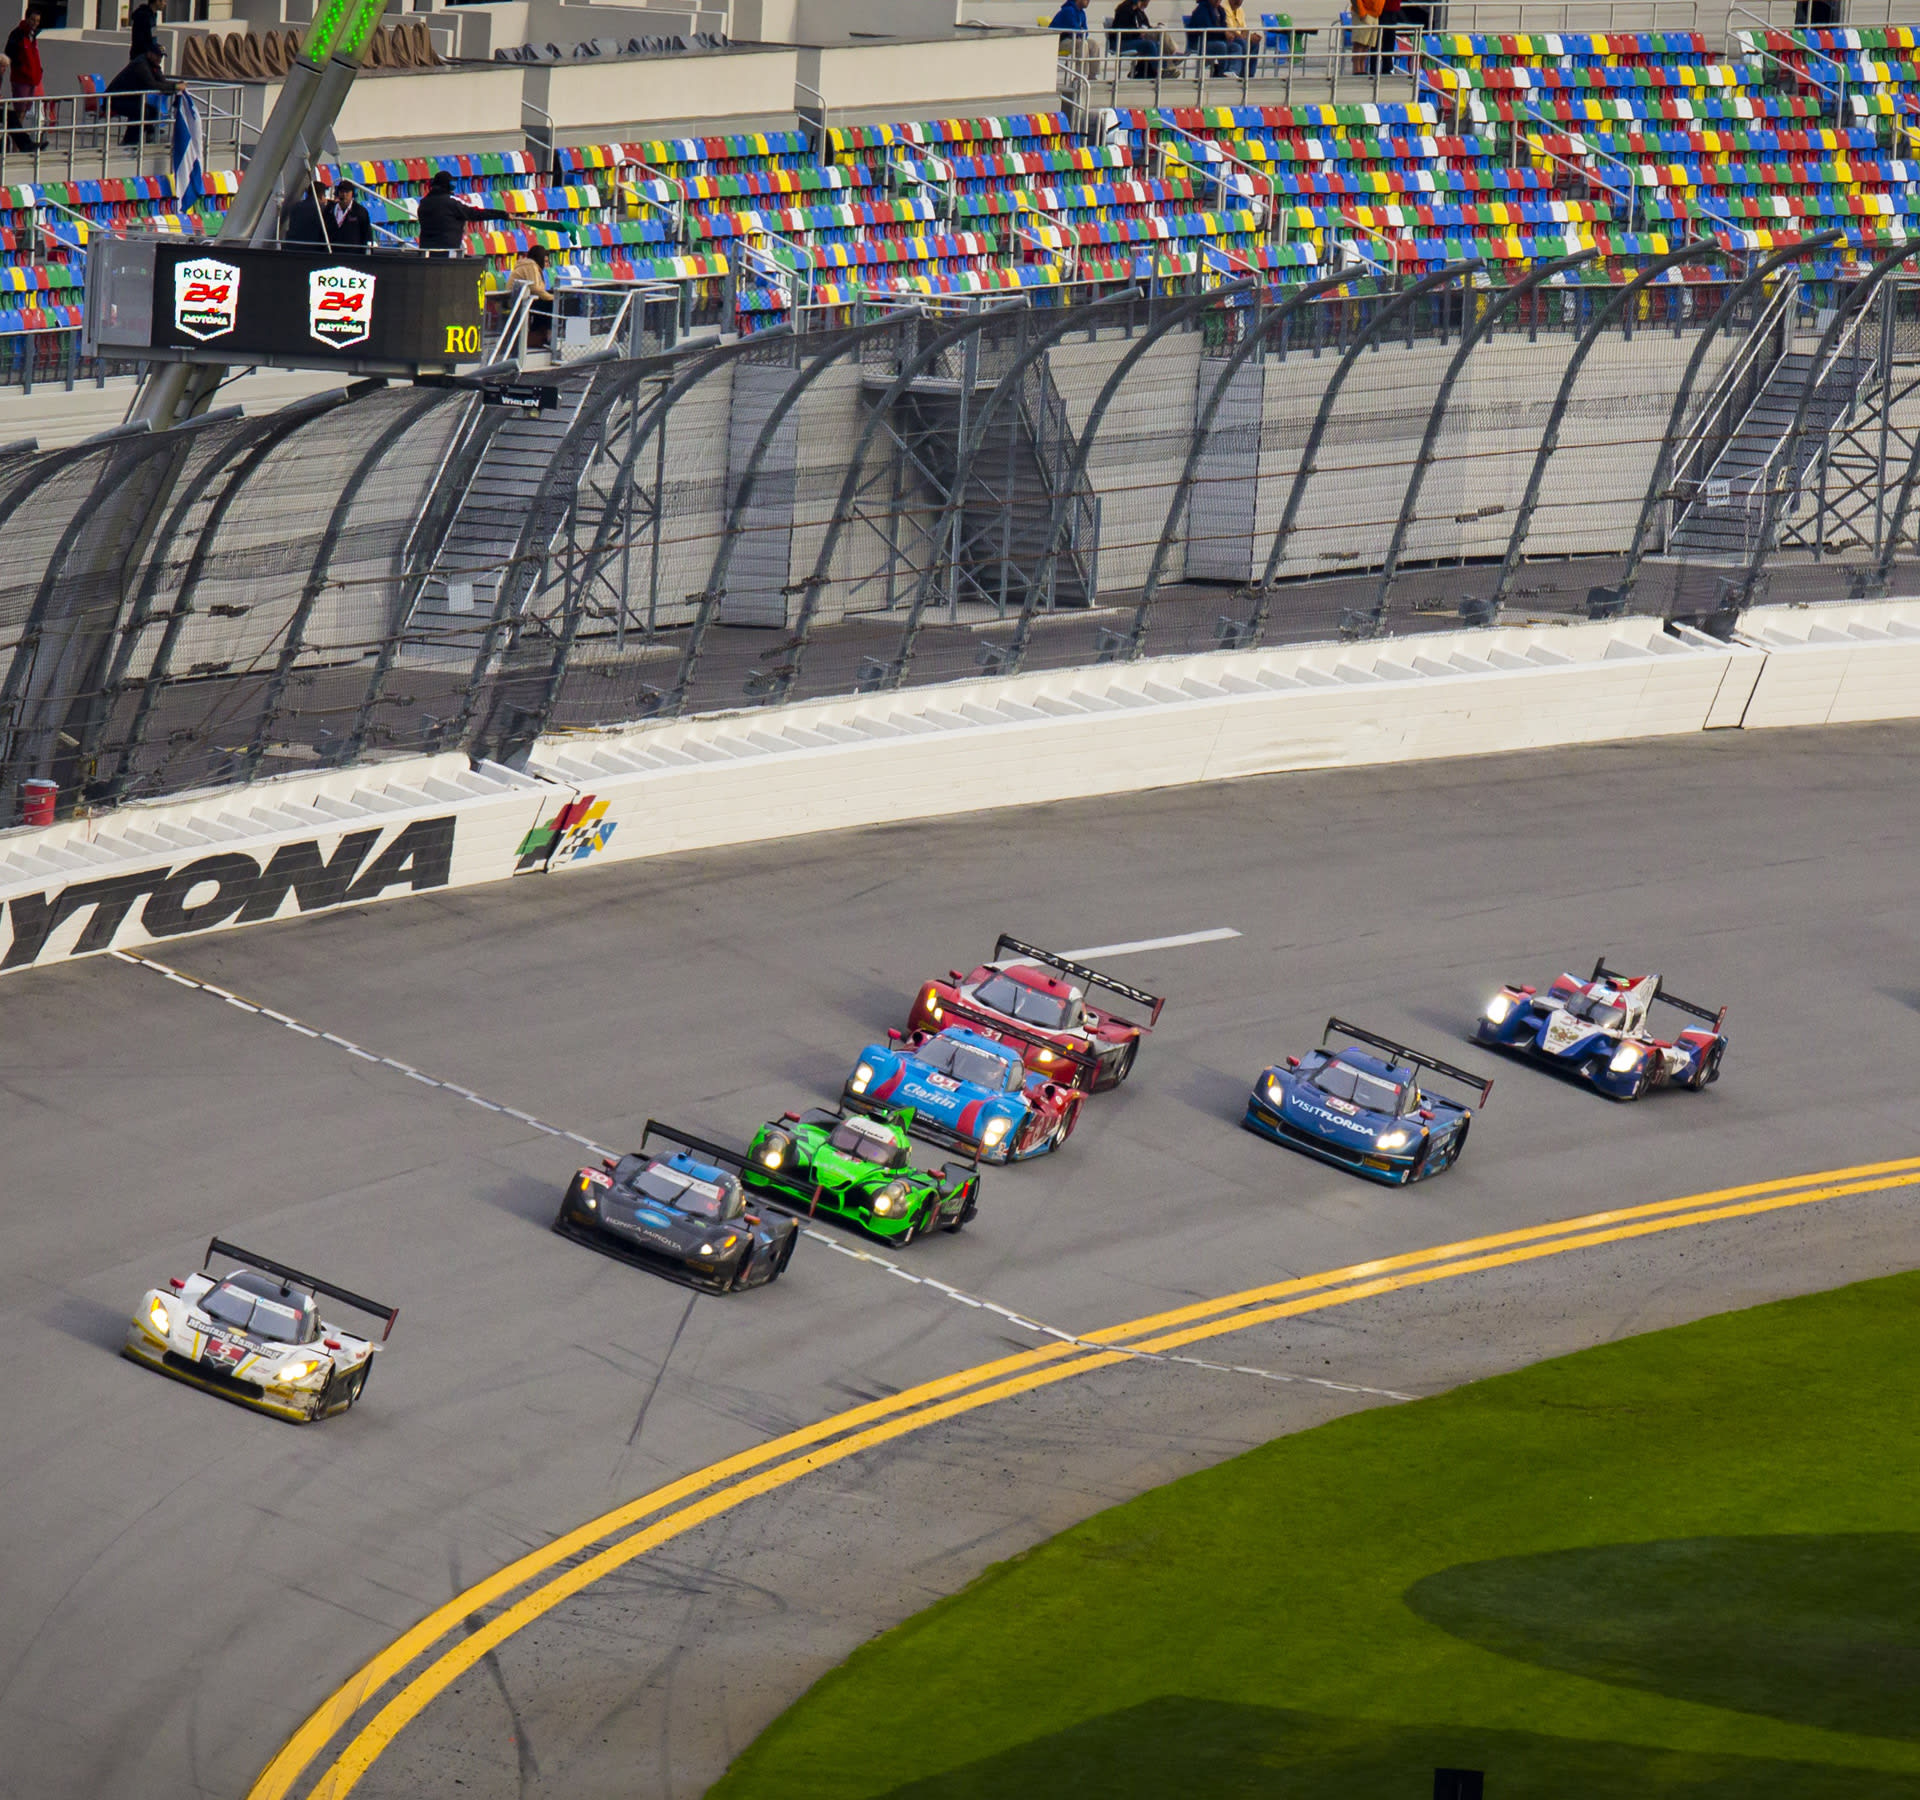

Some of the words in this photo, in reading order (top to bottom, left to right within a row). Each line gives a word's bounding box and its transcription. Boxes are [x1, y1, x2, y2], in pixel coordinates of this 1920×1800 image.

[183, 267, 233, 281] ROLEX
[318, 275, 367, 289] ROLEX
[183, 282, 230, 304] 24
[318, 291, 365, 312] 24
[182, 313, 228, 326] DAYTONA
[317, 321, 363, 334] DAYTONA
[501, 395, 540, 408] WHELEN
[0, 815, 456, 970] YTONA
[981, 1027, 1003, 1041] 31
[187, 1317, 232, 1342] Mustang
[231, 1332, 280, 1360] Sampling
[217, 1342, 233, 1355] 5
